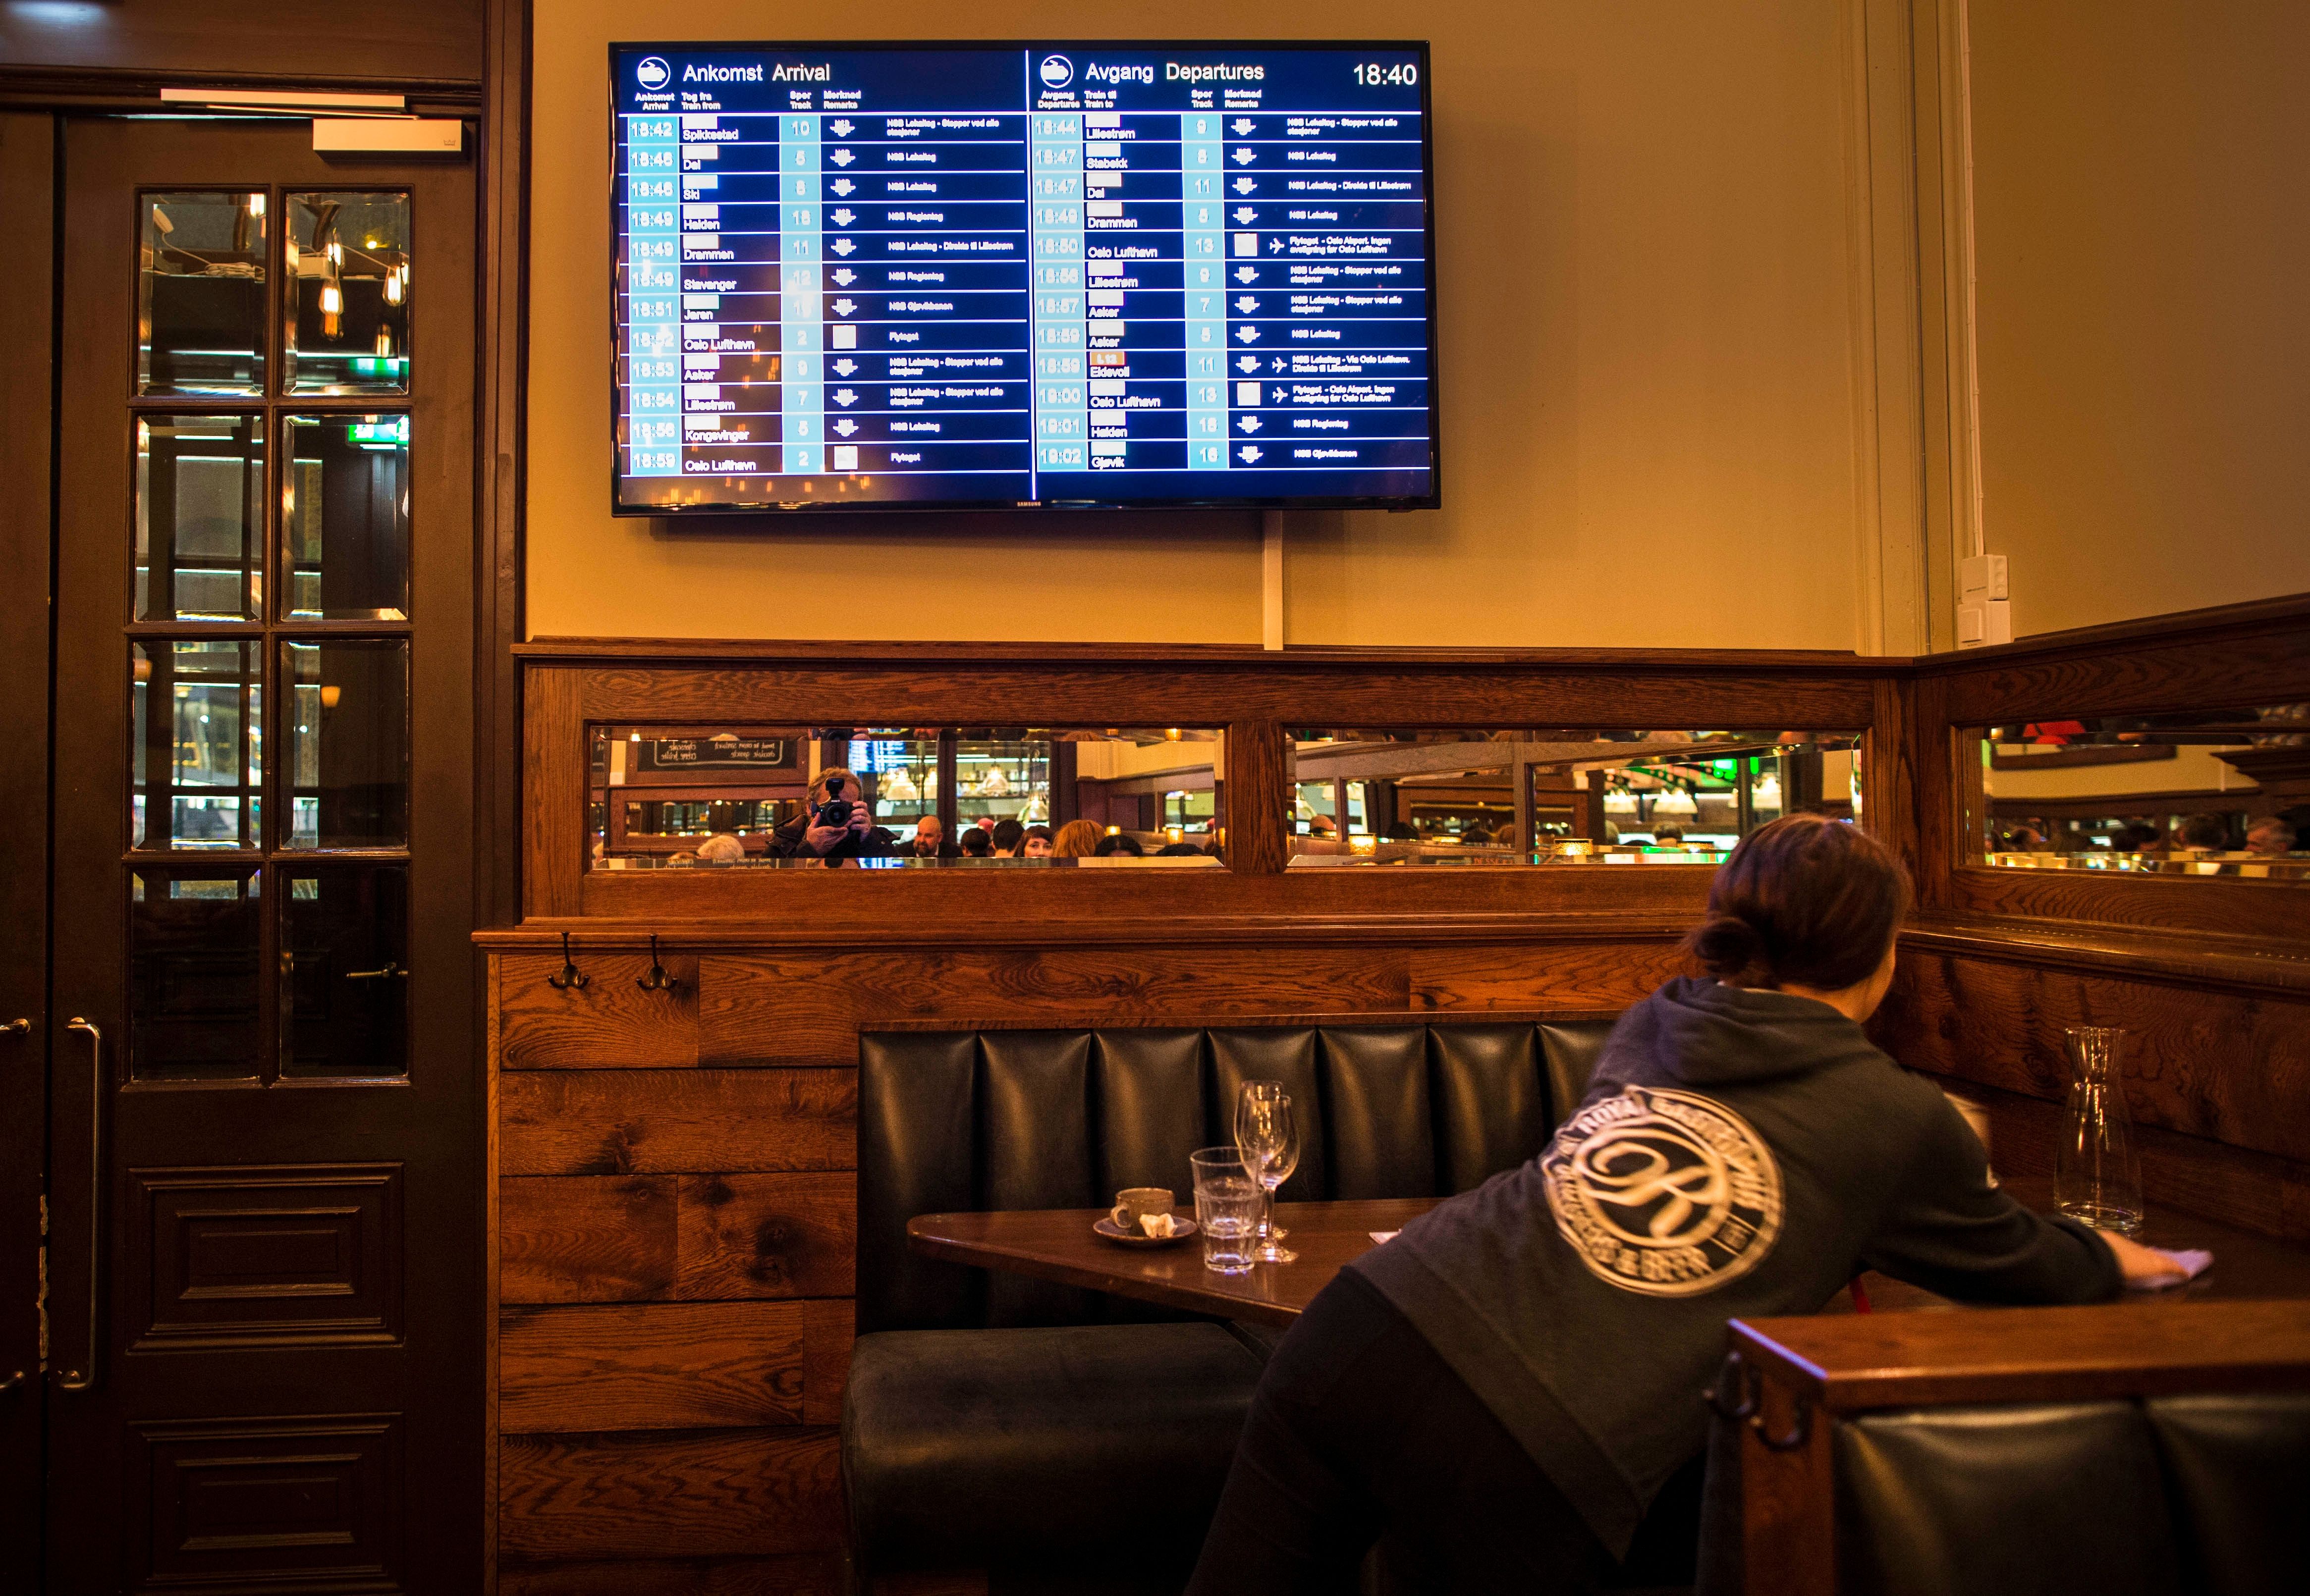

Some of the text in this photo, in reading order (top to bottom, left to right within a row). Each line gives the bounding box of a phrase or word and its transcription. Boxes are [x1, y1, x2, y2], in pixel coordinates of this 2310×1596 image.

[683, 63, 830, 82] Ankomst Arrival
[1085, 63, 1265, 84] Avgang Departures
[1354, 63, 1417, 85] 18:40
[635, 92, 675, 102] Ankomst
[681, 92, 712, 103] Tog fra
[790, 90, 812, 101] Spor
[824, 90, 862, 100] Merknad
[1041, 90, 1075, 101] Avgang
[1191, 89, 1213, 101] Spor
[1224, 89, 1262, 98] Merknad
[642, 102, 669, 110] Arrival
[681, 100, 721, 110] Train from
[790, 101, 812, 109] Track
[824, 101, 858, 109] Remarks
[1038, 100, 1080, 109] Departures
[1084, 100, 1114, 108] Train to
[1191, 100, 1213, 108] Track
[1224, 100, 1259, 108] Remarks
[631, 122, 672, 137] 18:42
[792, 121, 810, 136] 10
[1035, 119, 1076, 135] 18:44
[1197, 119, 1207, 134] 9
[683, 129, 739, 142] Spikkestad
[1086, 128, 1136, 139] Lillestrøm
[1036, 149, 1076, 164] 18:47
[683, 159, 701, 170] Dal
[1086, 158, 1128, 169] Stabekk
[1036, 178, 1077, 195] 18:47
[1195, 178, 1210, 193] 11
[683, 188, 700, 200] Ski
[1087, 187, 1105, 199] Dal
[632, 212, 674, 226] 18:49
[1036, 208, 1078, 224] 18:49
[684, 219, 720, 230] Halden
[1088, 217, 1138, 228] Drammen
[632, 241, 674, 257] 18:49
[793, 240, 809, 255] 11
[1196, 238, 1214, 253] 13
[684, 249, 734, 260] Drammen
[1088, 246, 1157, 258] Oslo Lufthavn
[792, 269, 812, 285] 12
[1200, 267, 1210, 282] 9
[684, 279, 737, 292] Stavanger
[1089, 276, 1138, 288] Lillestrøm
[632, 301, 673, 317] 18:51
[1201, 297, 1210, 312] 7
[684, 309, 714, 320] Jaren
[1089, 306, 1119, 318] Asker
[797, 329, 807, 345] 2
[1089, 336, 1120, 348] Asker
[684, 339, 755, 351] Oslo Lufthavn
[632, 362, 675, 377] 18:53
[1199, 357, 1213, 373] 11
[684, 369, 715, 380] Asker
[1090, 366, 1130, 377] Eidsvoll
[633, 392, 675, 408] 18:54
[798, 390, 808, 406] 7
[1039, 388, 1081, 403] 19:00
[1199, 387, 1217, 403] 13
[1090, 396, 1160, 408] Oslo Lufthavn
[798, 420, 809, 436] 5
[1040, 418, 1079, 433] 19:01
[1091, 426, 1128, 437] Halden
[685, 429, 750, 443] Kongsvinger
[633, 453, 676, 468] 18:59
[798, 451, 809, 466] 2
[1040, 448, 1082, 464] 19:02
[685, 460, 757, 472] Oslo Lufthavn
